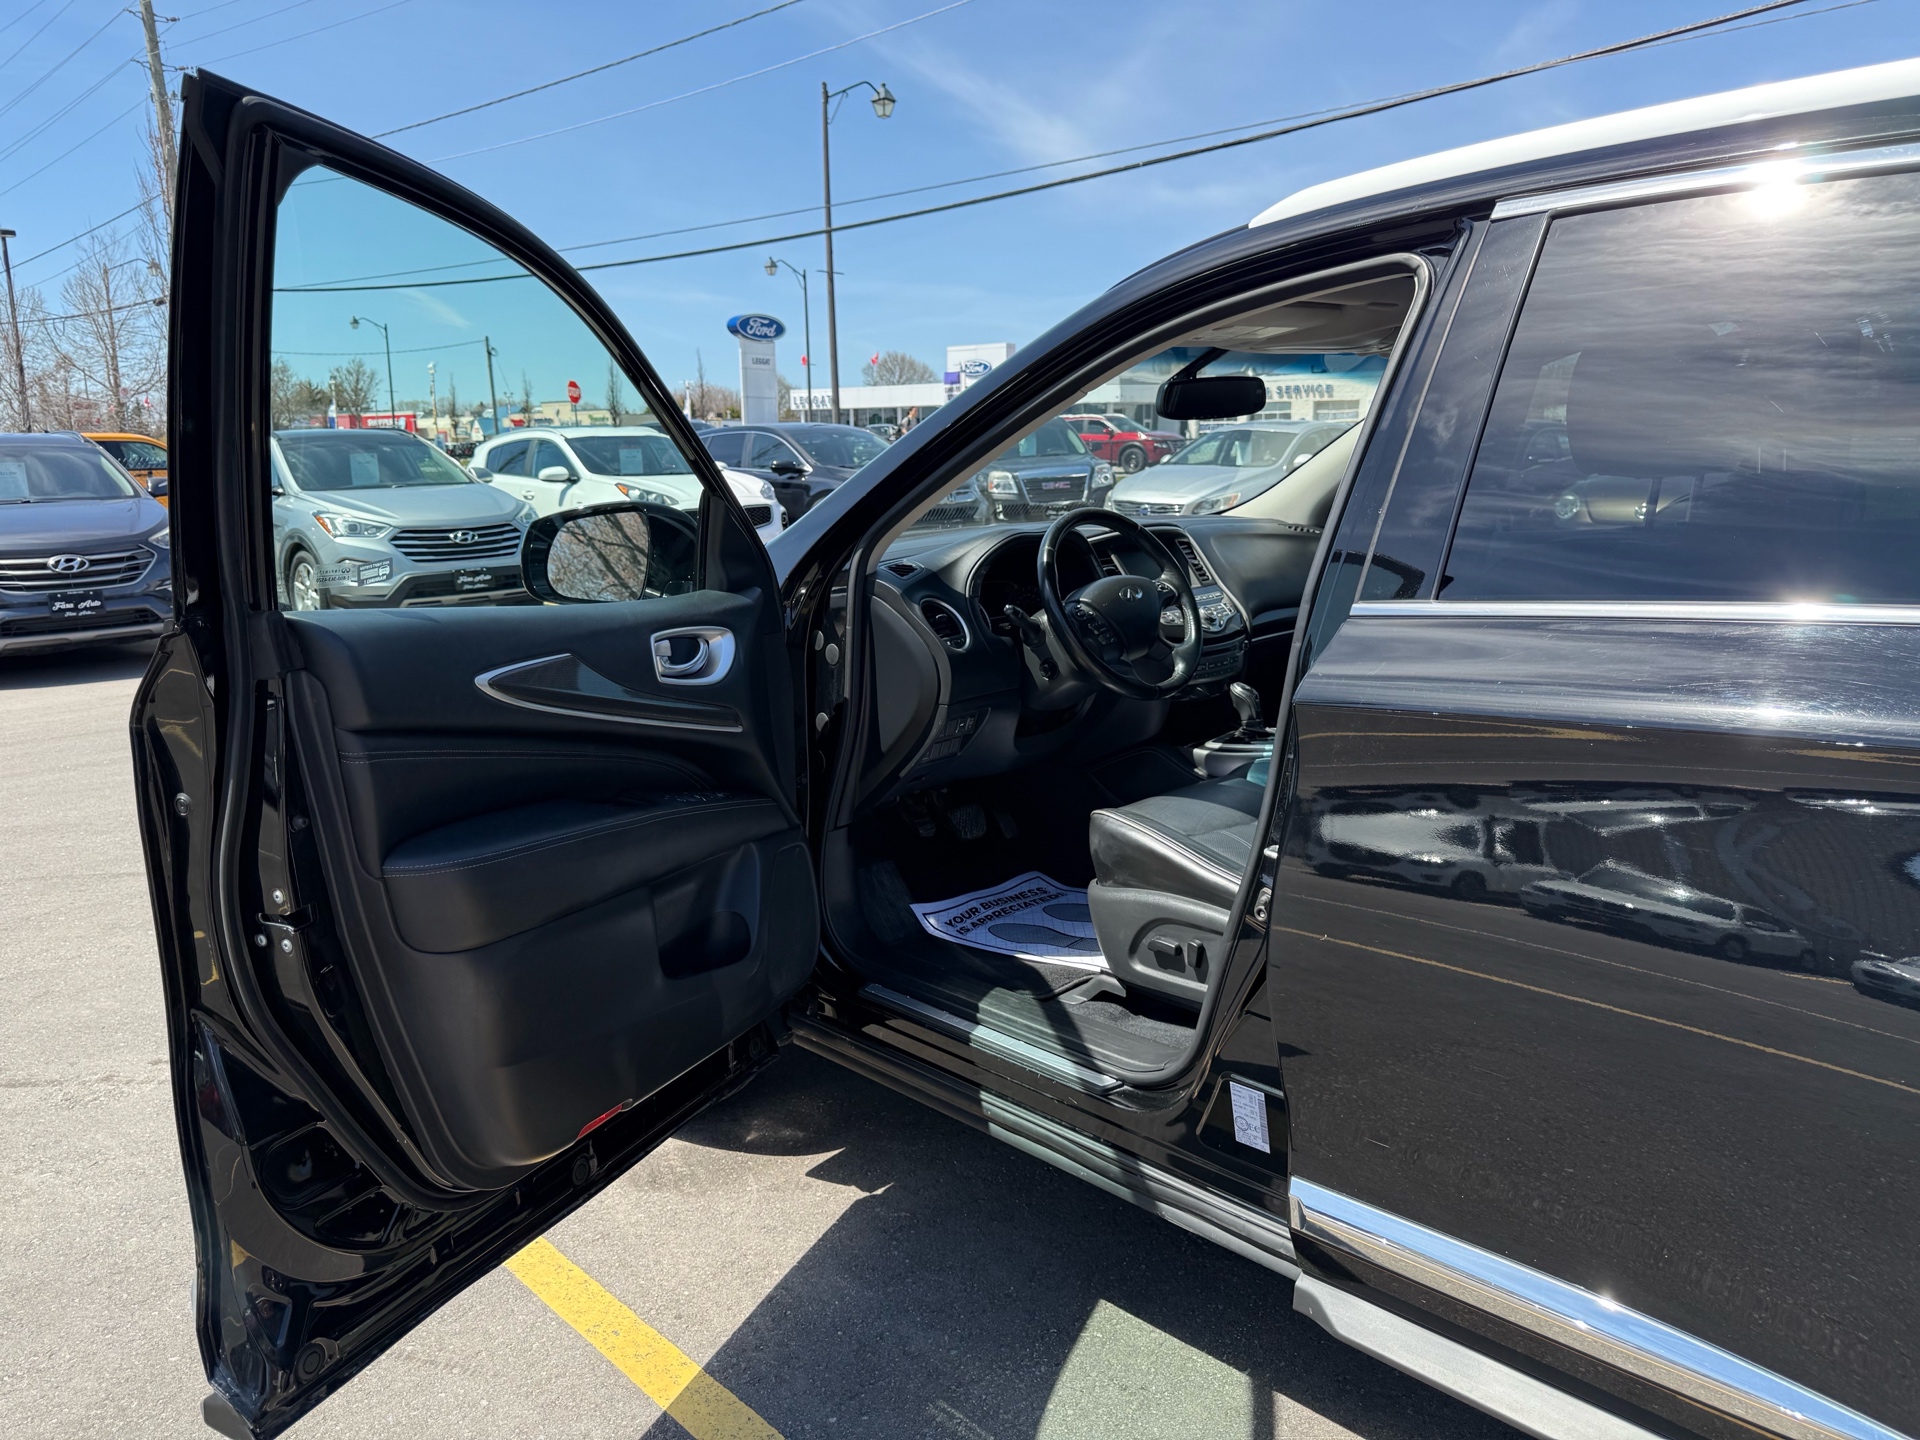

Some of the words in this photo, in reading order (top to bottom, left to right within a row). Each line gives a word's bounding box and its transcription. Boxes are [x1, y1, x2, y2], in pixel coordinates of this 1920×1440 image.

[746, 317, 777, 337] Ford
[1276, 384, 1334, 397] SERVICE
[77, 599, 102, 609] Auto
[944, 906, 981, 929] YOUR
[980, 886, 1048, 912] BUSINESS
[956, 925, 972, 937] IS
